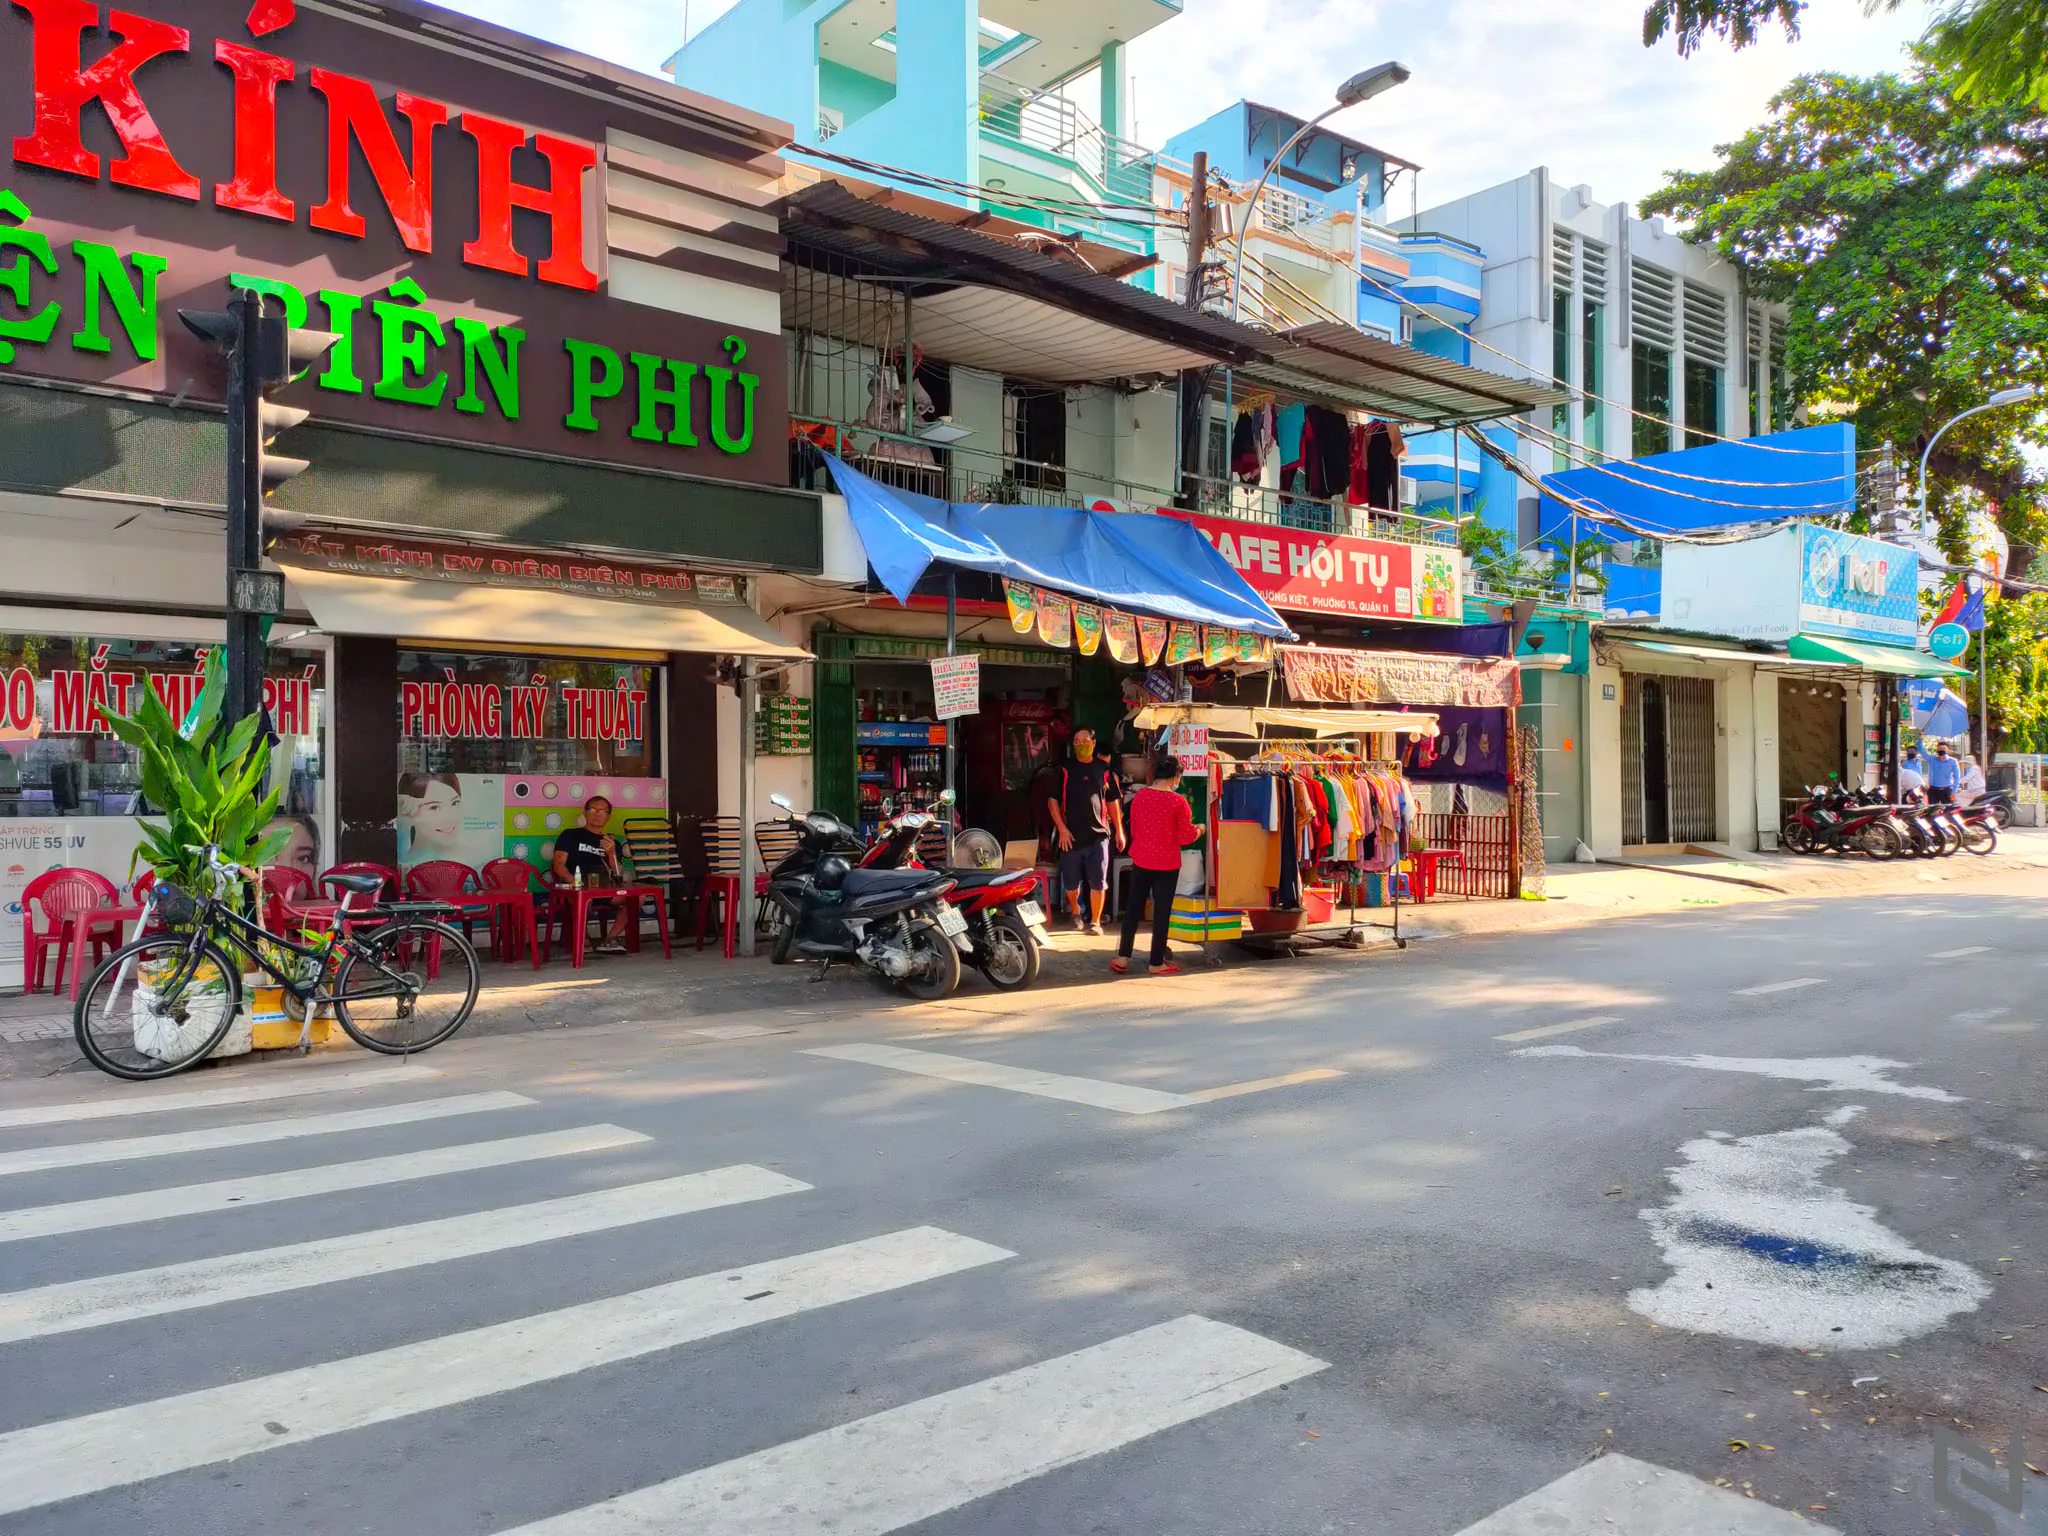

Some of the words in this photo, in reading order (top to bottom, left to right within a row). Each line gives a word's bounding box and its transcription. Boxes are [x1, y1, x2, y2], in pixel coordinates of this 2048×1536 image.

[13, 0, 599, 292] KÍNH
[564, 335, 760, 456] PHỦ
[357, 544, 433, 568] KÍNH
[443, 553, 484, 573] BV
[569, 565, 634, 586] BIÊN
[641, 572, 692, 591] PHỦ
[1288, 539, 1343, 587] HỘI
[1349, 551, 1389, 594] TỤ
[1765, 623, 1789, 633] Foods
[1932, 633, 1965, 645] Feli
[51, 644, 135, 733] MẮT
[402, 667, 502, 739] PHÒNG
[511, 673, 549, 739] KỸ
[563, 676, 647, 750] THUẬT
[43, 836, 63, 849] 55
[67, 836, 86, 849] UV
